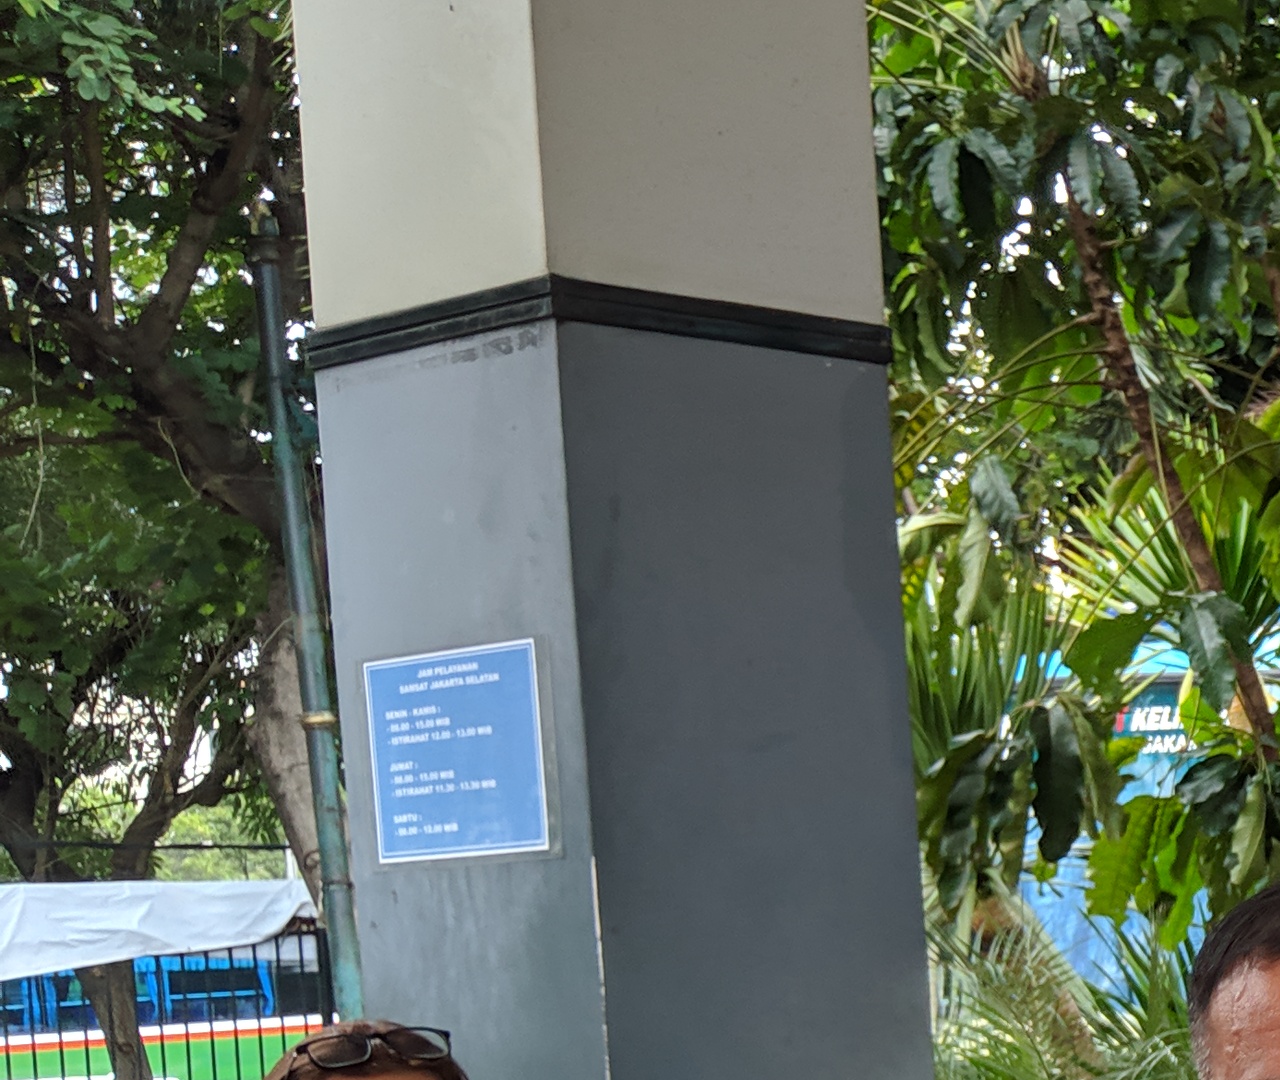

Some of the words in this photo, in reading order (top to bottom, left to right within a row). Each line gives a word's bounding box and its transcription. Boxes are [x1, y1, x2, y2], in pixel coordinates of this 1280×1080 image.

[417, 668, 433, 679] JAM
[434, 662, 479, 676] PELAYANAN
[399, 682, 428, 695] SAMSAT
[430, 677, 464, 690] JAKARTA
[465, 672, 500, 685] SELATAN
